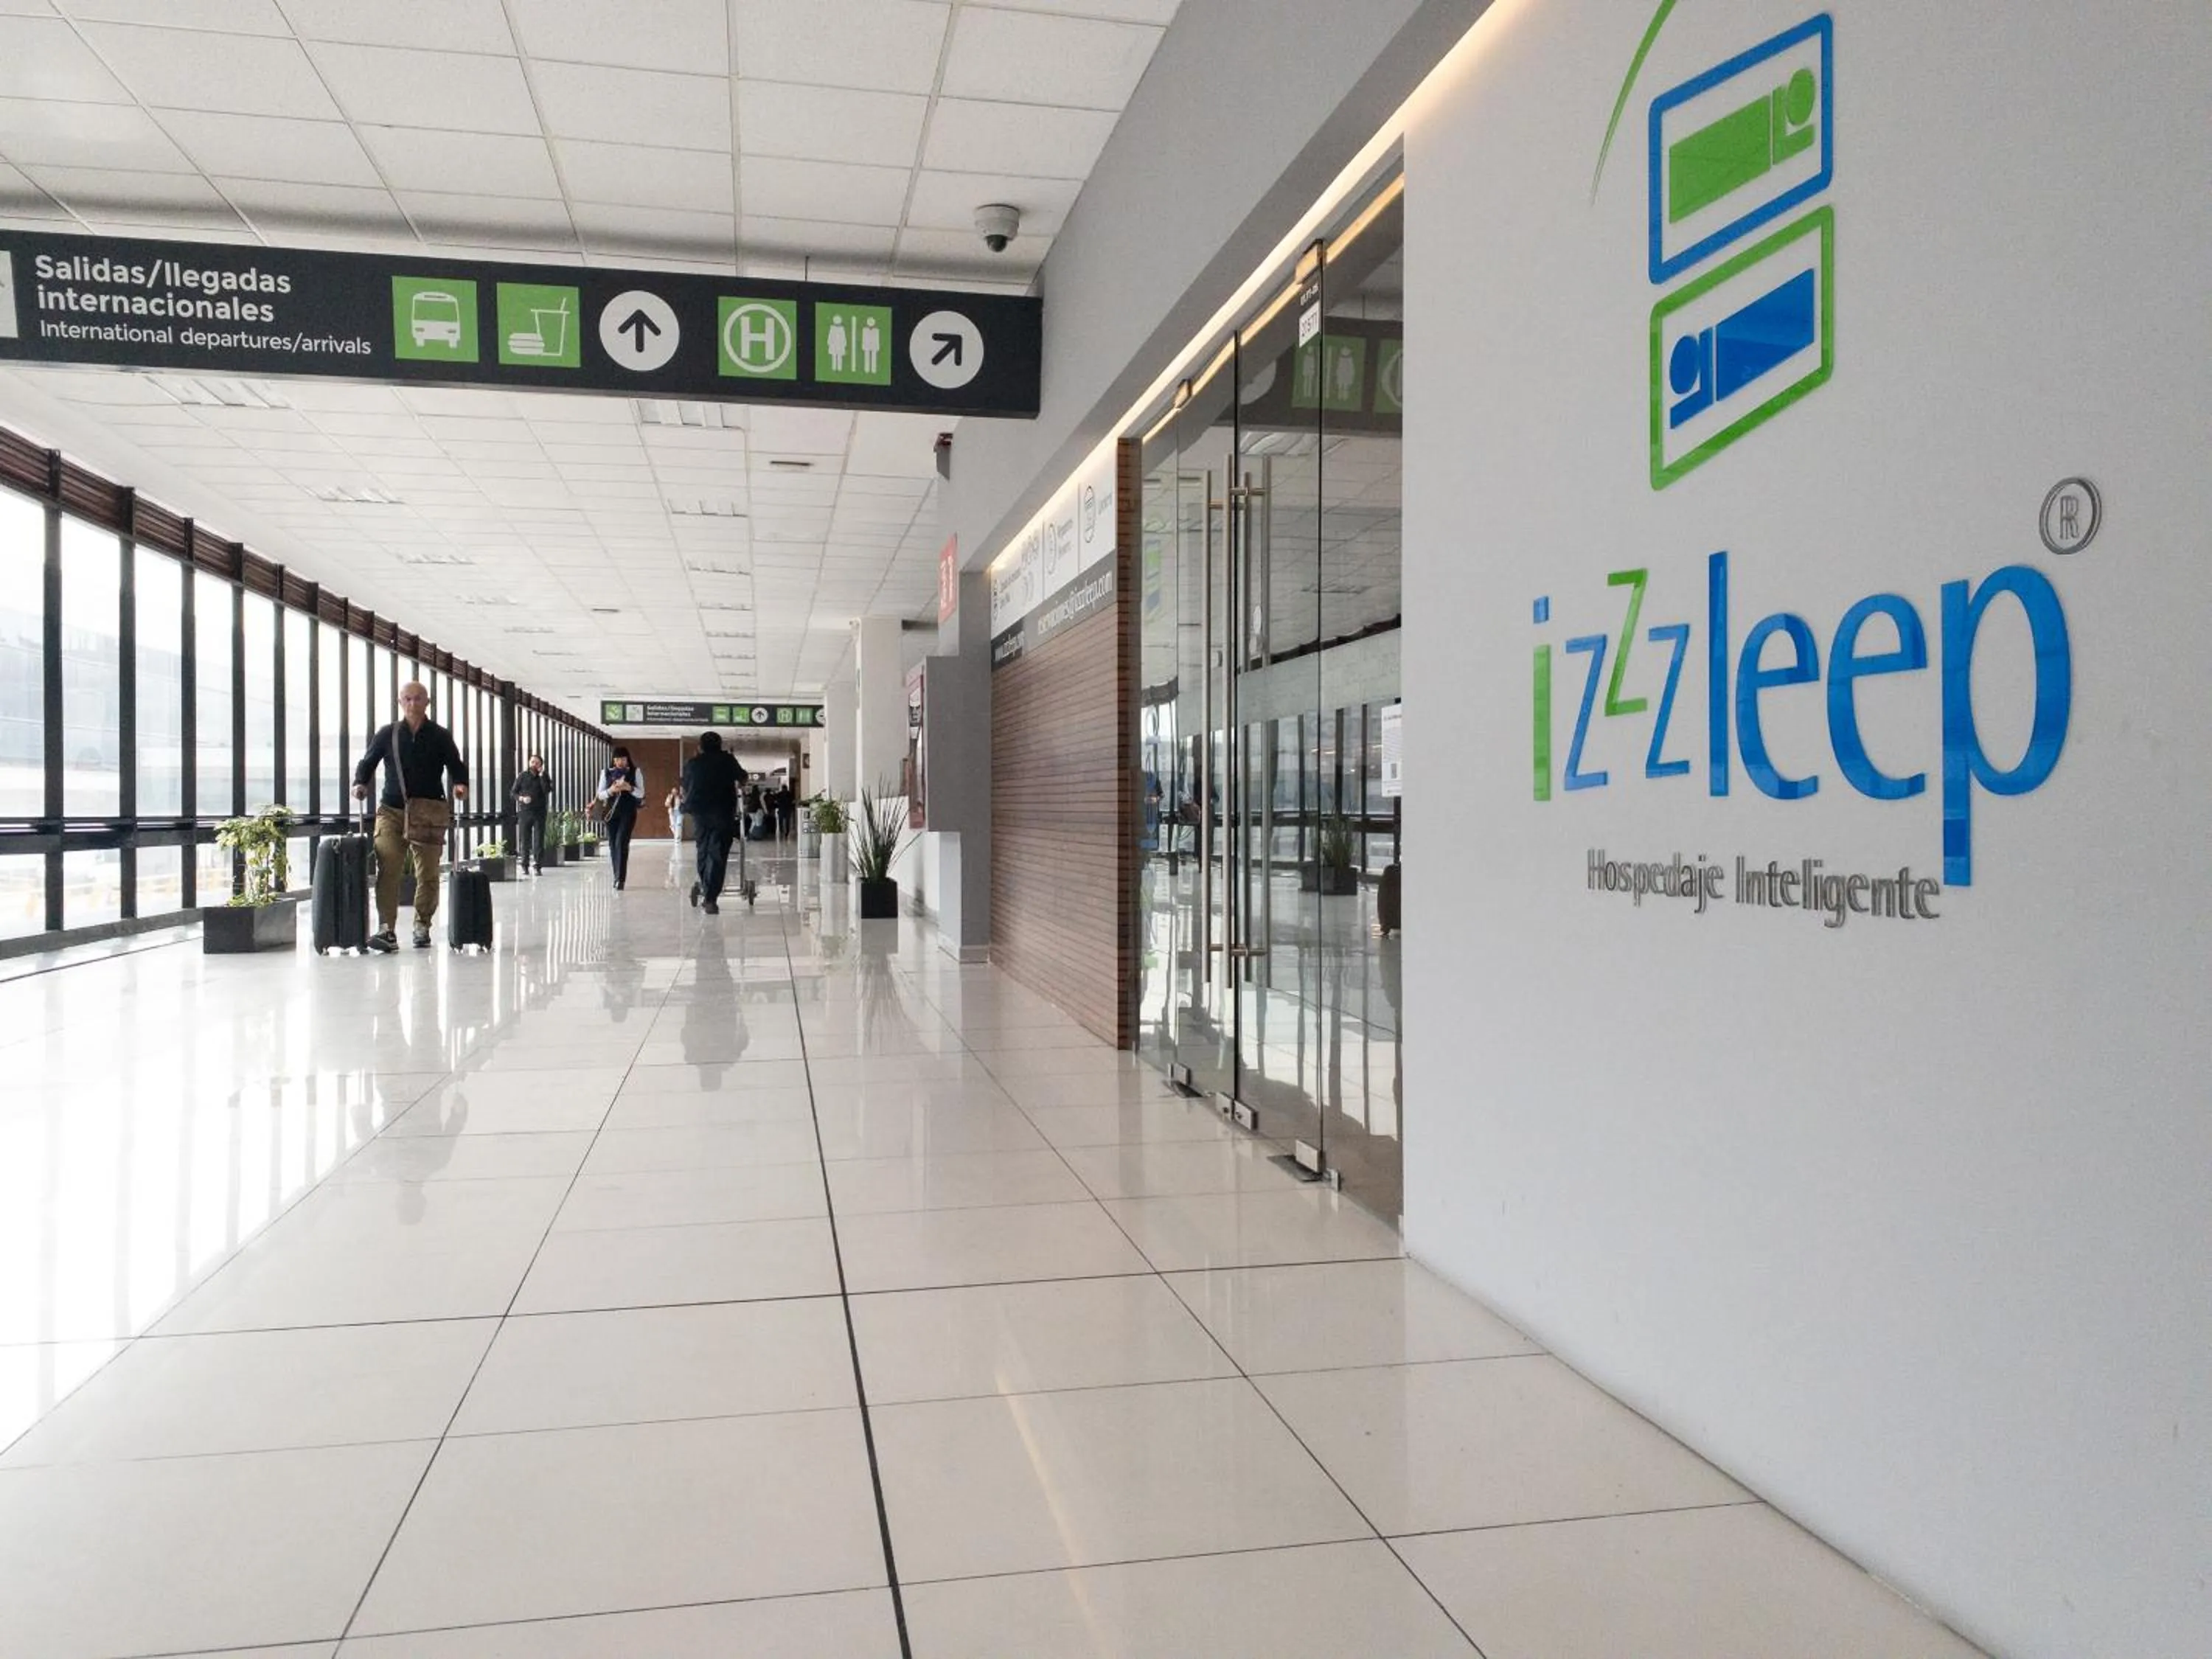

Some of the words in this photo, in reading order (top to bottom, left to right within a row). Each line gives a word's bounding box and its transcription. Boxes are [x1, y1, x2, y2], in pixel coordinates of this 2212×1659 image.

[35, 254, 291, 294] Salidas/llegadas
[37, 285, 274, 322] internacionales
[41, 319, 173, 344] International
[180, 327, 371, 355] departures/arrivals
[1587, 848, 1724, 914] Hospedaje
[1735, 855, 1940, 928] Inteligente
